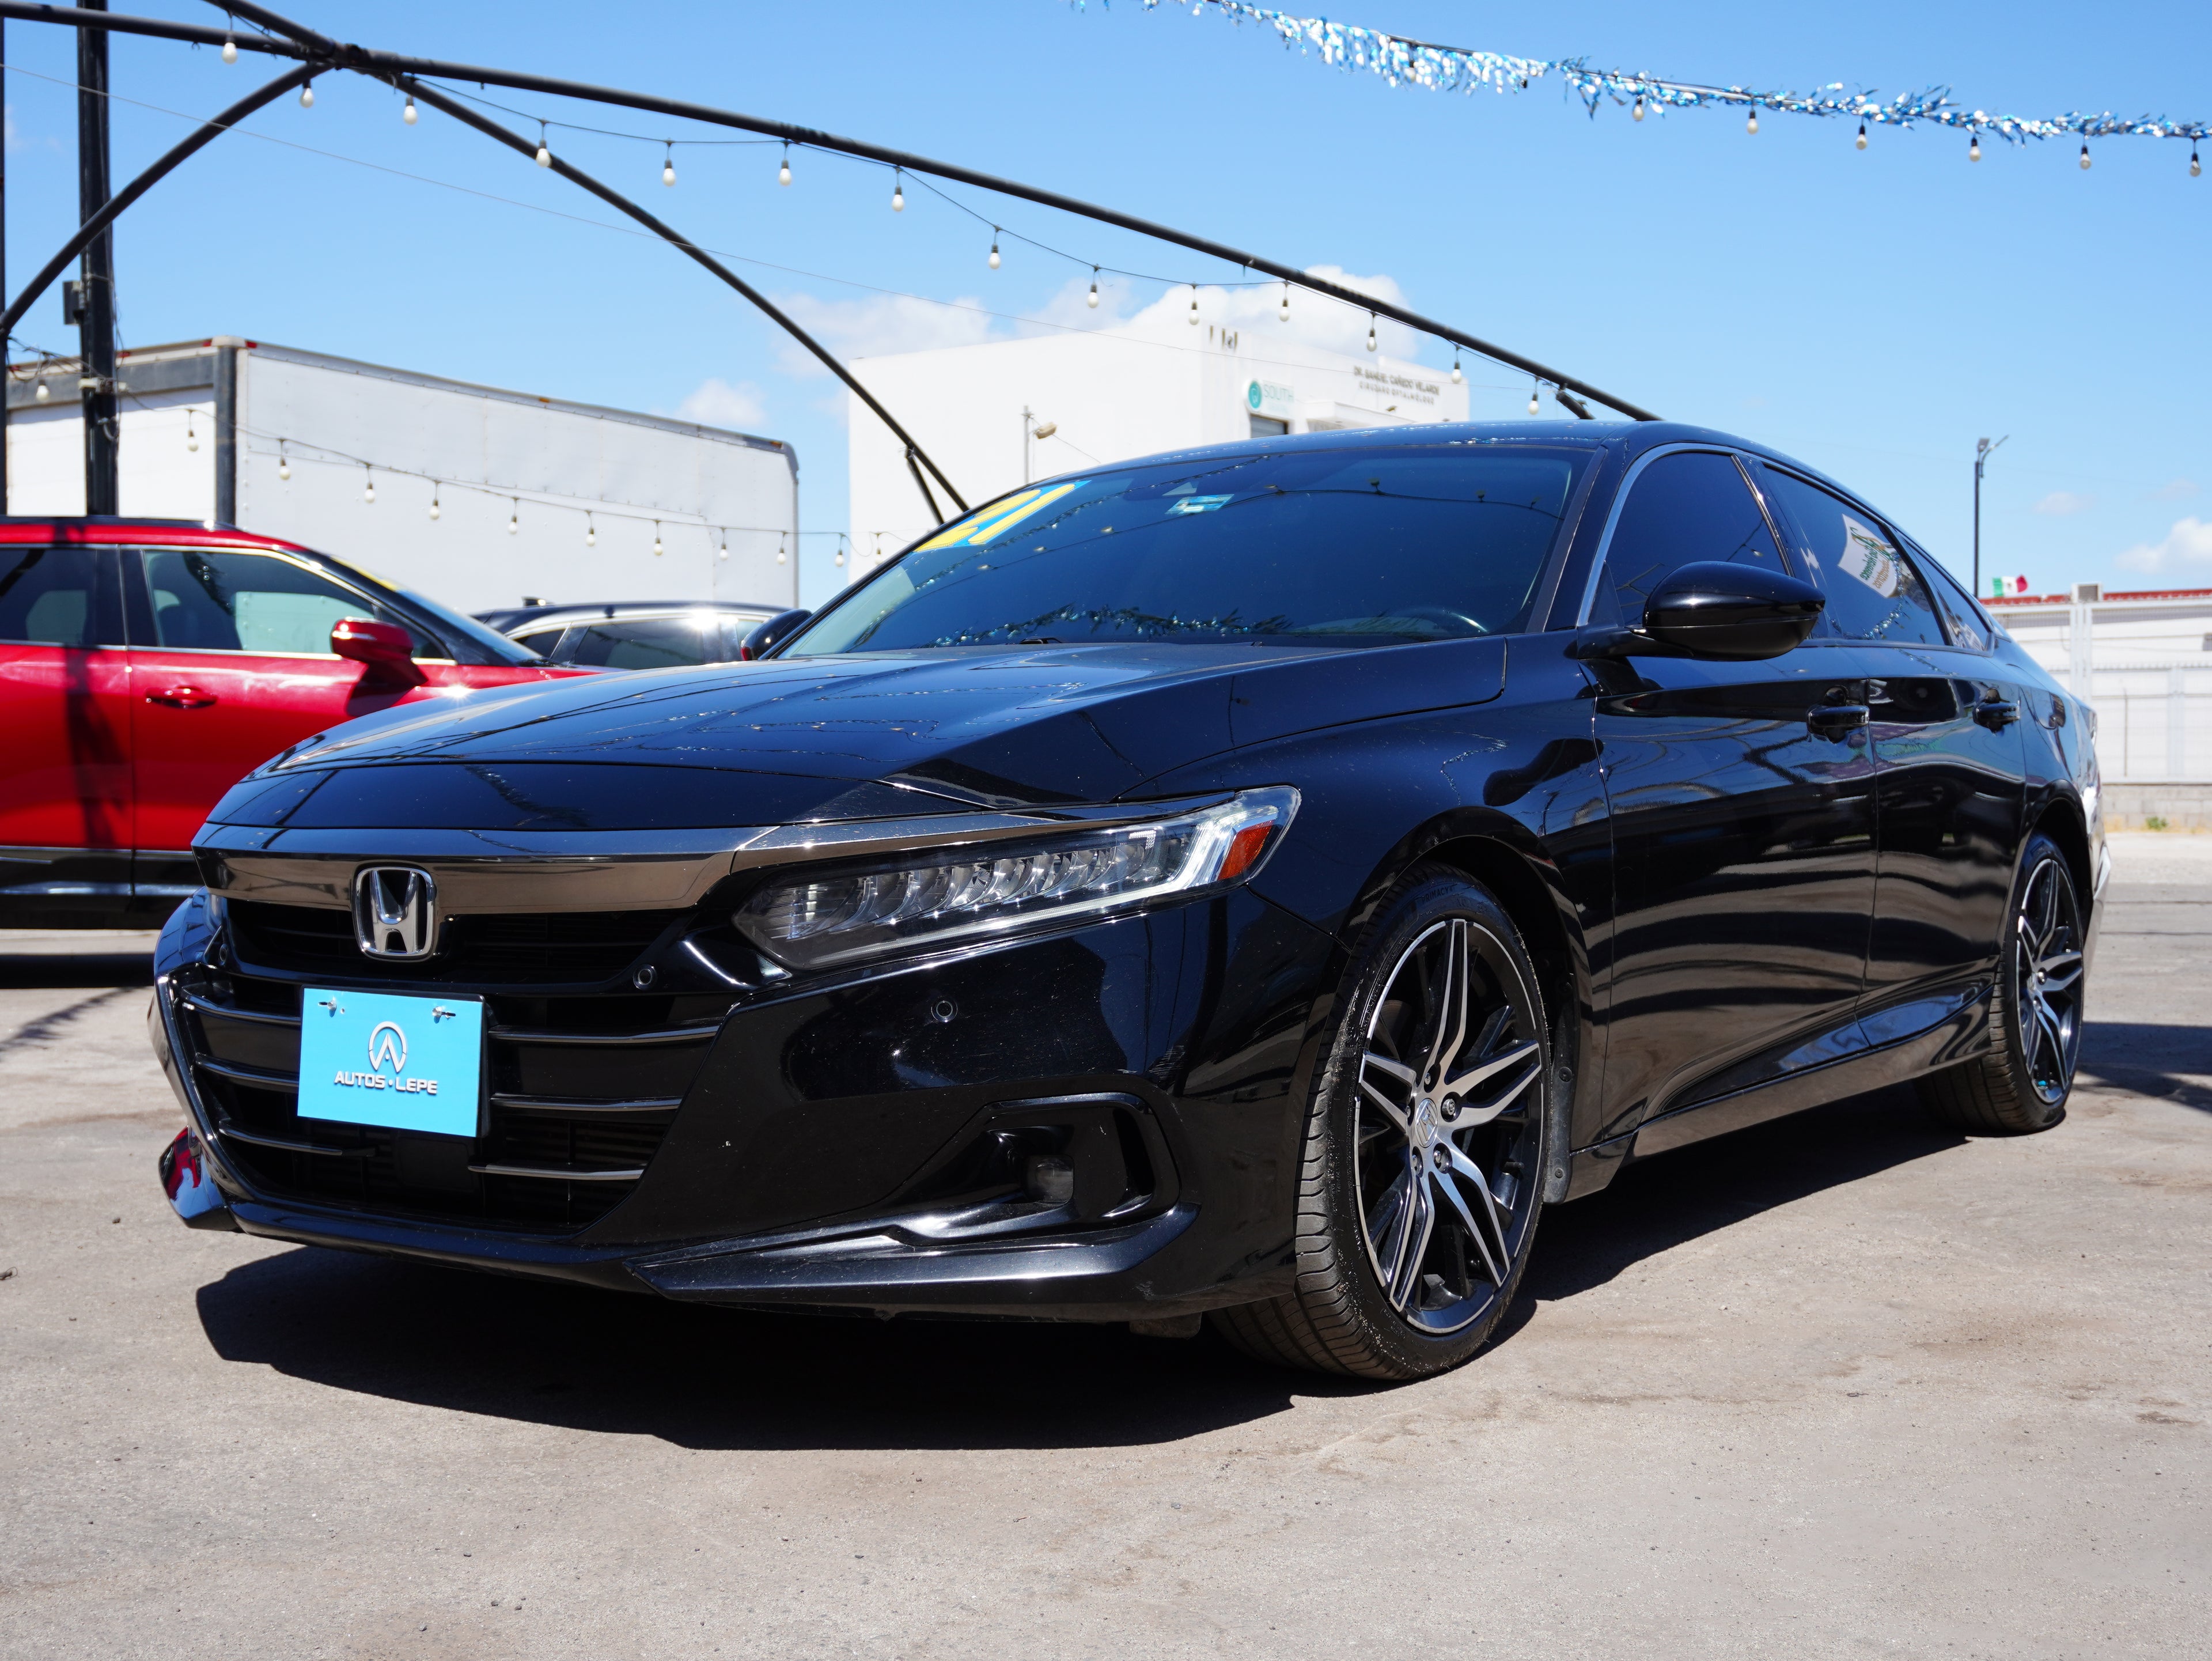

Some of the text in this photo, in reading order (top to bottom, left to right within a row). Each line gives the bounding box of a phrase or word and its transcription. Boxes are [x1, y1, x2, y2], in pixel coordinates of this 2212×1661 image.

[1263, 384, 1294, 402] SOUTH
[1422, 887, 1449, 903] PRIMACY
[334, 1070, 438, 1095] AUTOS LEPE
